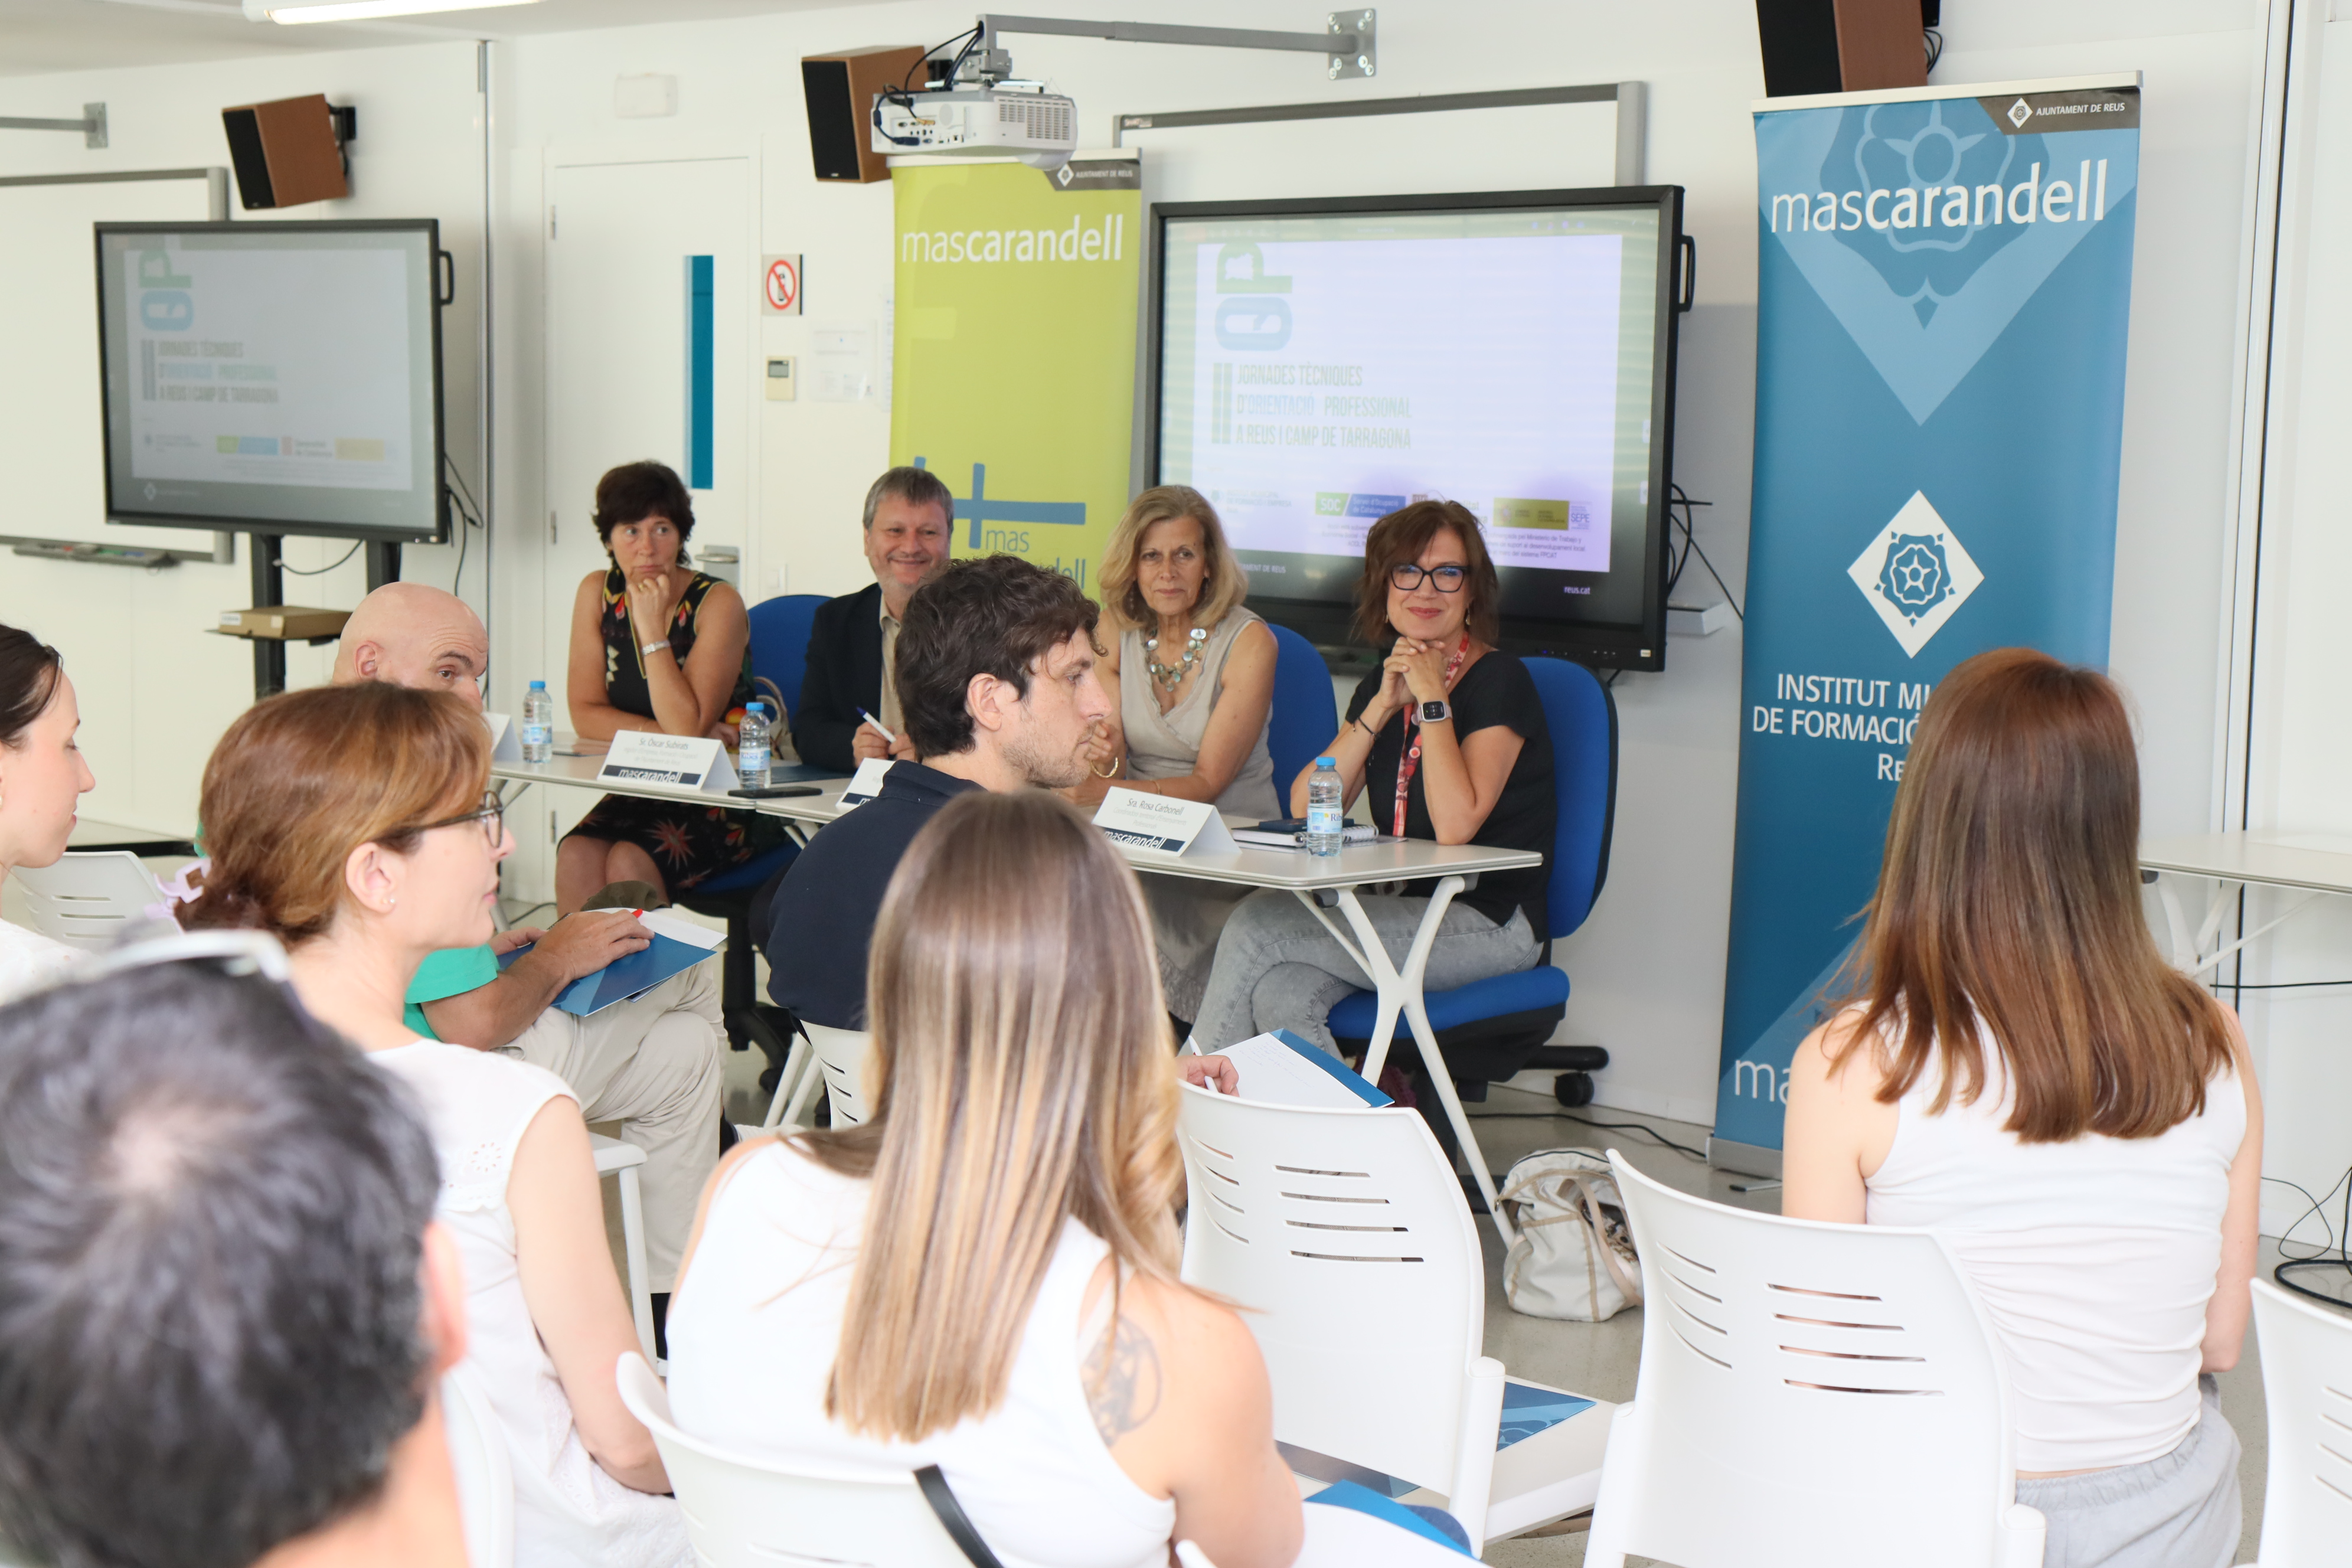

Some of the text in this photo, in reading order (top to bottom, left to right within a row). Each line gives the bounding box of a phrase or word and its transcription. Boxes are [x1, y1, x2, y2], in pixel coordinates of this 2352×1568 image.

[2036, 103, 2125, 116] AJUNTAMENT DE REUS
[1772, 158, 2108, 233] mascarandell
[902, 214, 1123, 262] mascarandell
[1238, 361, 1363, 387] JORNADES TÈCNIQUES
[1324, 396, 1412, 418] PROFESSIONAL
[1236, 424, 1243, 444] A
[1247, 424, 1276, 445] REUS
[1286, 426, 1319, 446] CAMP
[1322, 427, 1337, 447] DE
[1340, 427, 1412, 449] TARRAGONA
[1321, 498, 1341, 512] SOC
[1571, 513, 1590, 523] SEPE
[986, 530, 1030, 553] mas
[1564, 586, 1590, 594] reus.cat
[1778, 674, 1890, 707] INSTITUT
[1753, 706, 1783, 734] DE
[619, 769, 682, 783] mascarandell
[1127, 798, 1185, 815] Sra. Rosa Carbonell
[1105, 831, 1167, 850] mascarandell
